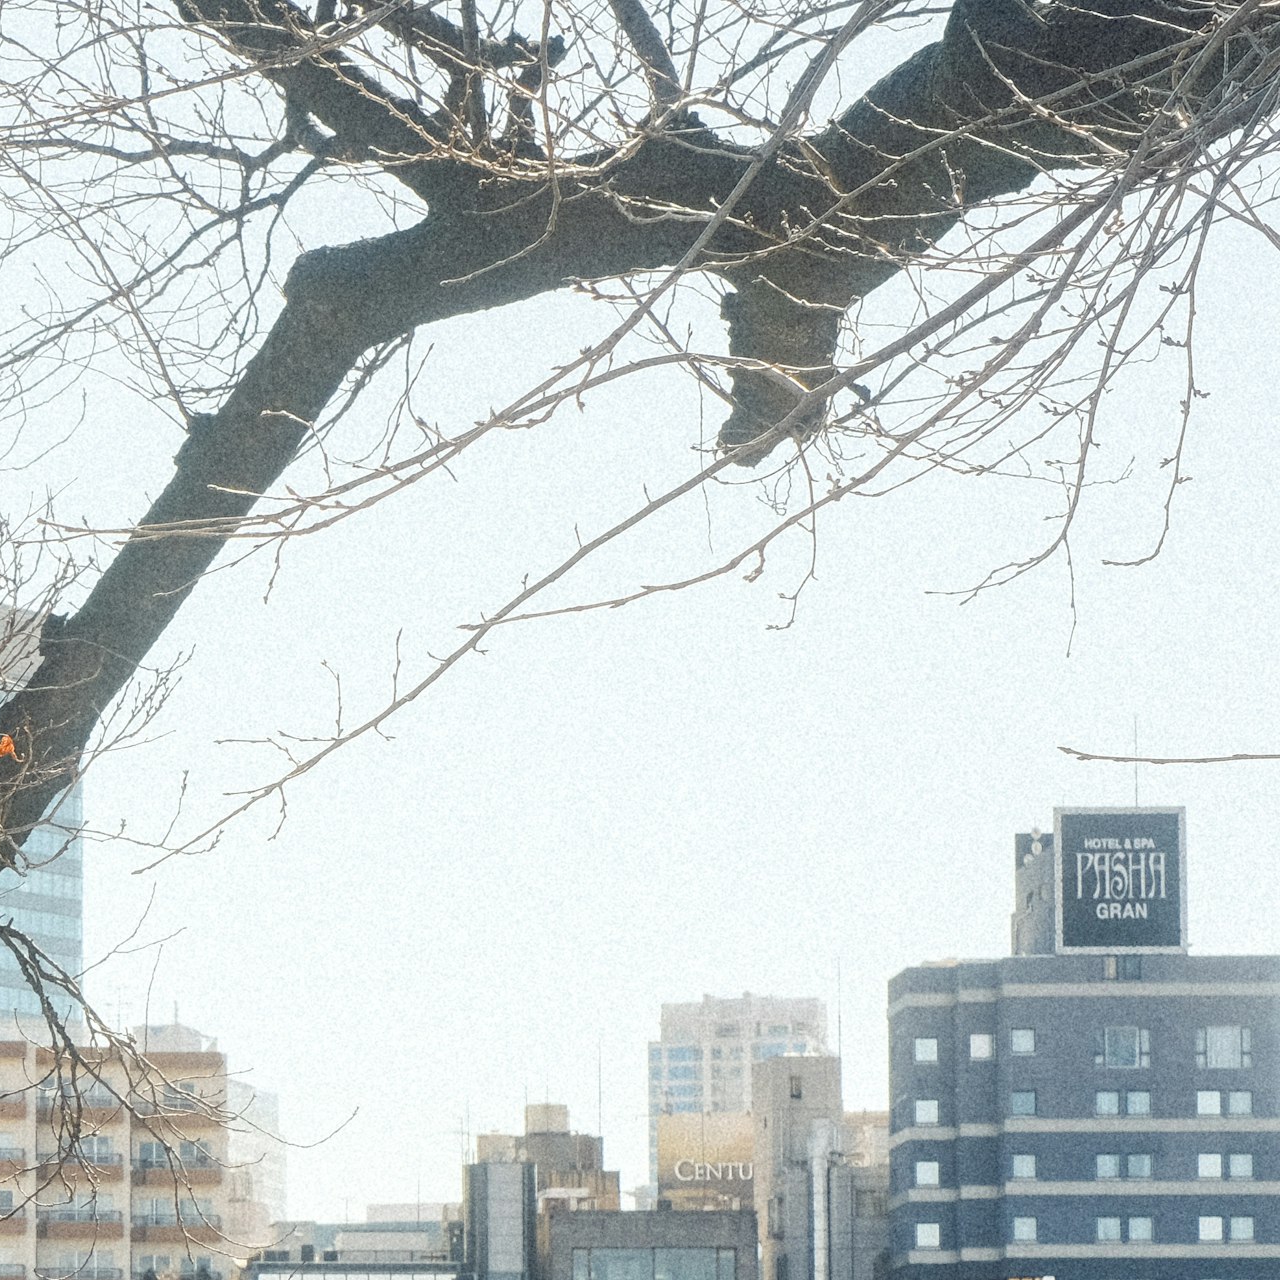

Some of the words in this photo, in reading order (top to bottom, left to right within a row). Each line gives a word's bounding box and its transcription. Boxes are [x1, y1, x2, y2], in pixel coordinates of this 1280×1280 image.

[1084, 838, 1122, 850] HOTEL
[1124, 838, 1133, 850] &
[1134, 838, 1156, 850] SPA
[1075, 852, 1166, 900] PASHA
[1096, 902, 1148, 920] GRAN
